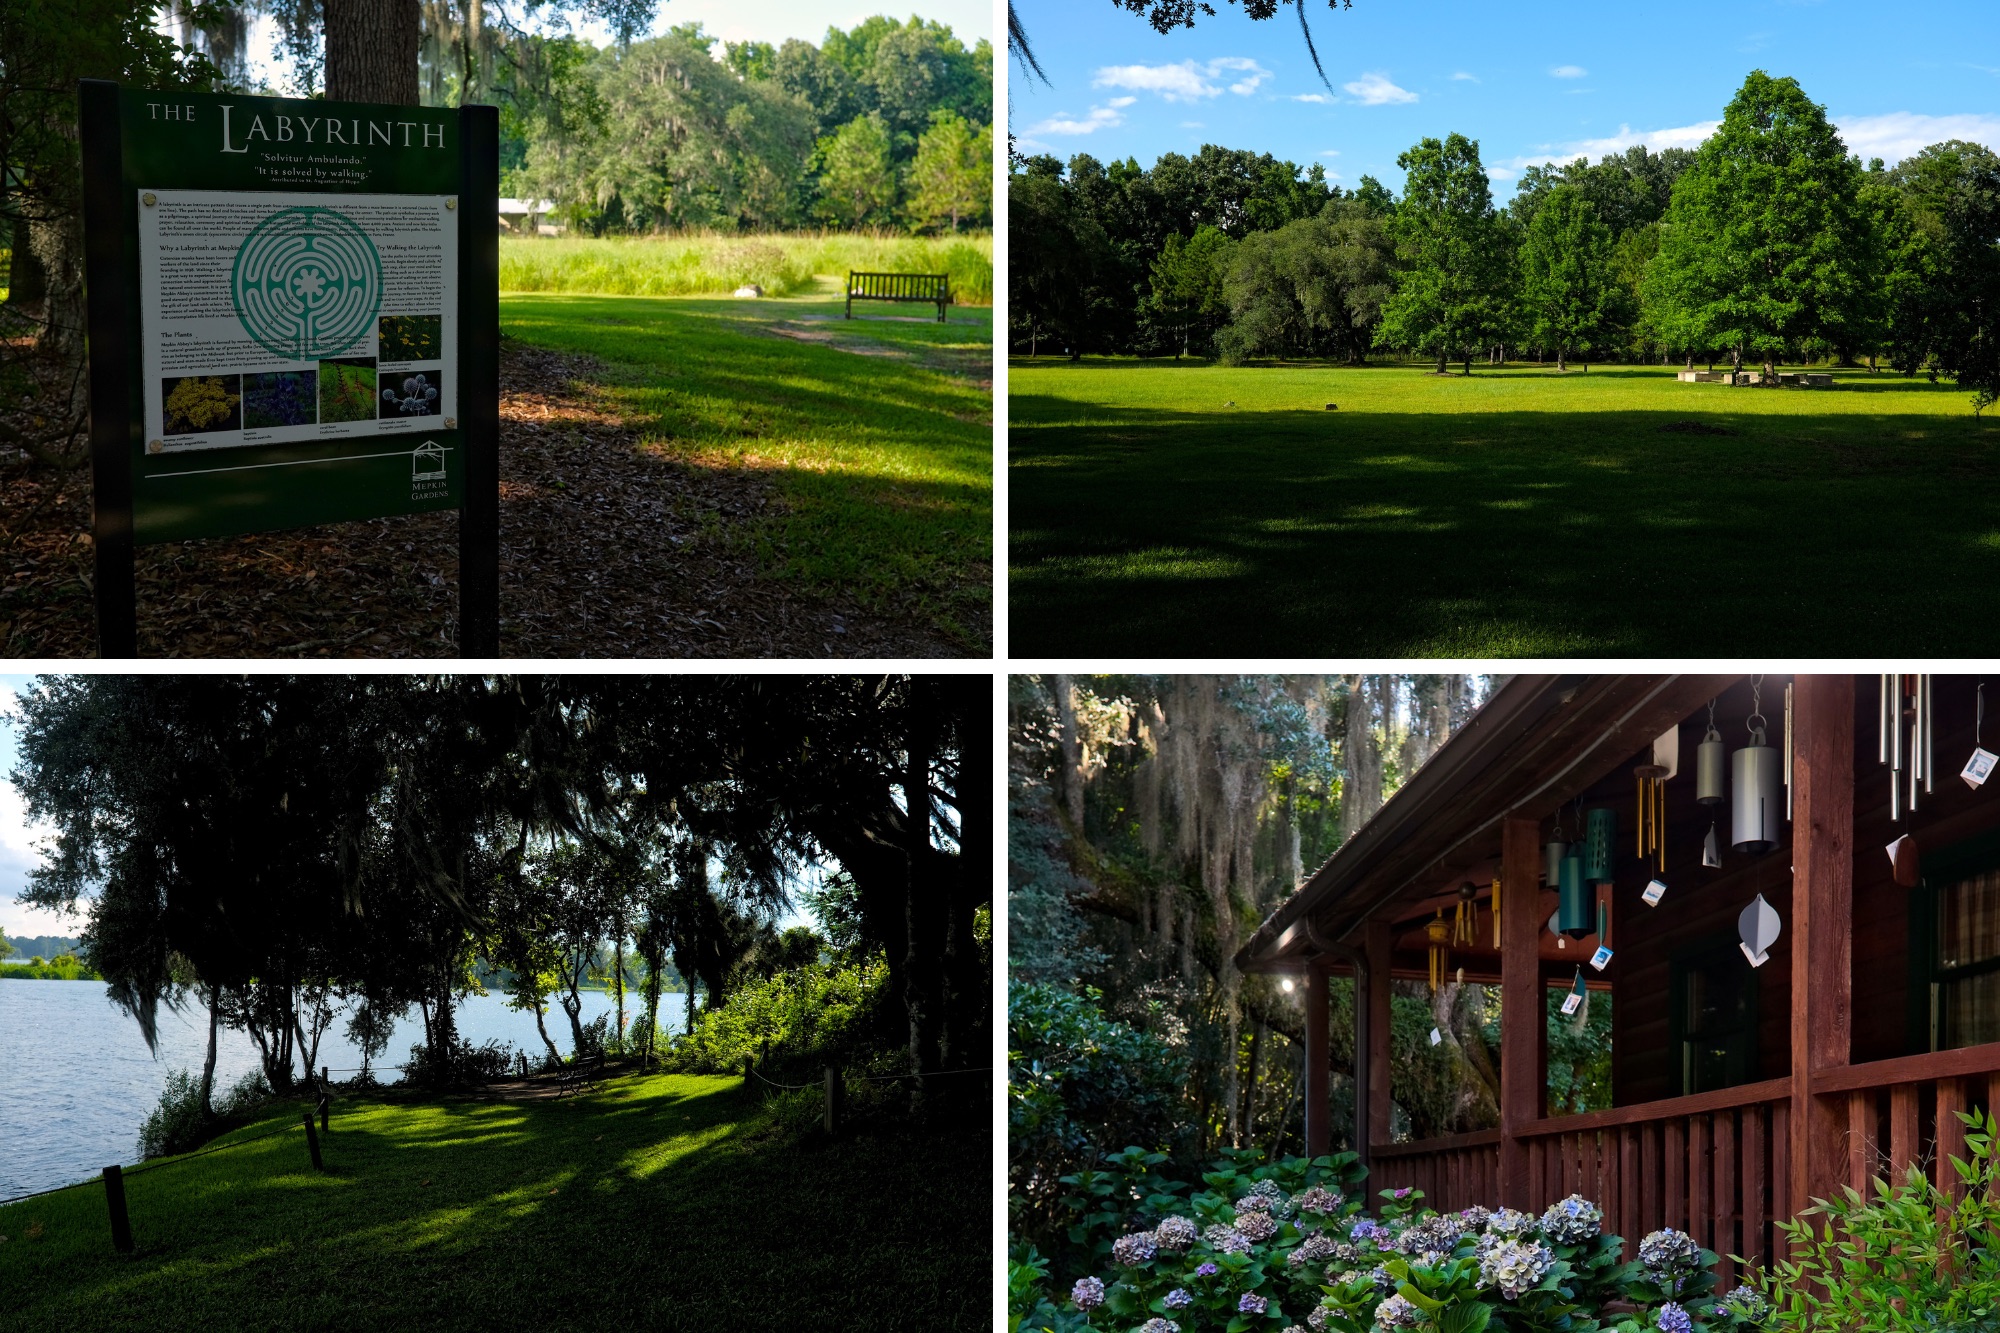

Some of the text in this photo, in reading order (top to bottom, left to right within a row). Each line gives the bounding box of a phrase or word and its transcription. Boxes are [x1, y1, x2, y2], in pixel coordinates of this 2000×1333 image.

[147, 103, 446, 154] THE LABYRINTH
[260, 153, 367, 165] "Solvitur Ambulando."
[254, 166, 373, 180] "It is solved by walking."
[412, 481, 447, 490] MEPKIN
[411, 491, 449, 500] GARDENS
